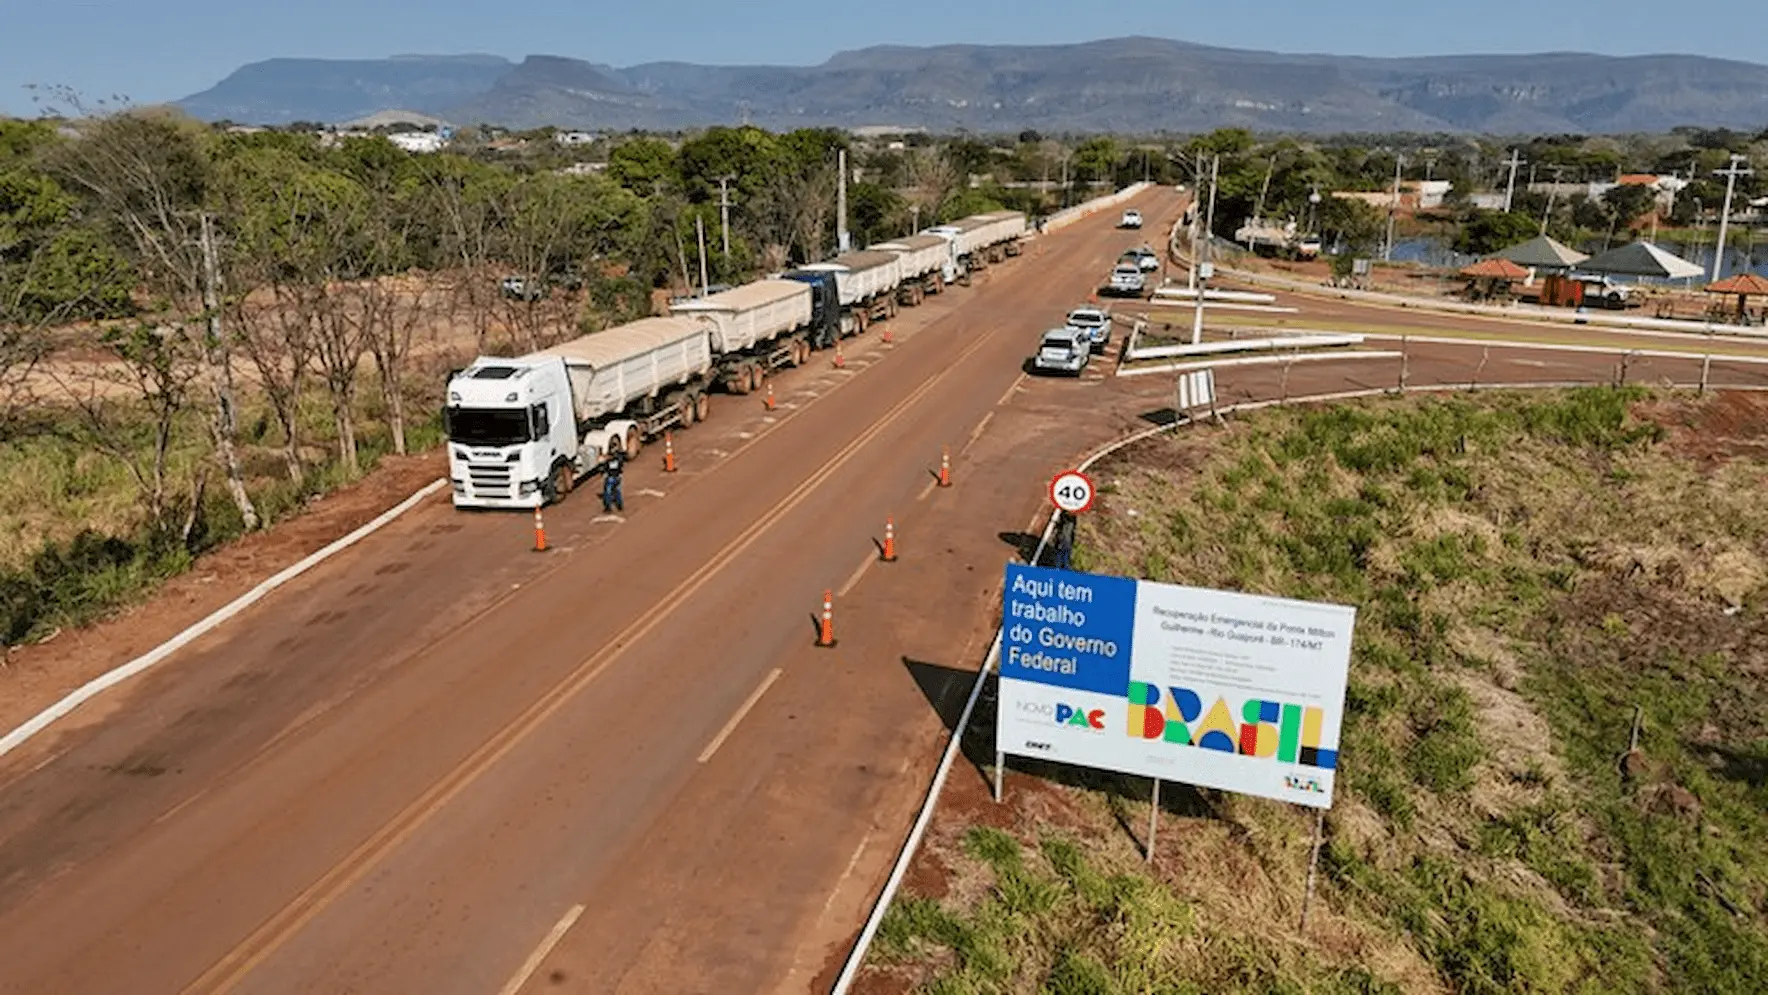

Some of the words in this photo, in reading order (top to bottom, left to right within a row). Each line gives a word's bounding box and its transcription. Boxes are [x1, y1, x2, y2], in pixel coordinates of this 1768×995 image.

[1058, 486, 1086, 500] 40
[1012, 573, 1054, 600] Aqui
[1058, 580, 1093, 603] tem
[1011, 599, 1086, 628] trabalho
[1211, 612, 1264, 629] Emergencial
[1009, 622, 1033, 644] do
[1038, 626, 1118, 658] Governo
[1008, 645, 1078, 675] Federal
[1055, 702, 1106, 729] PAC
[1127, 680, 1338, 769] BRASIL
